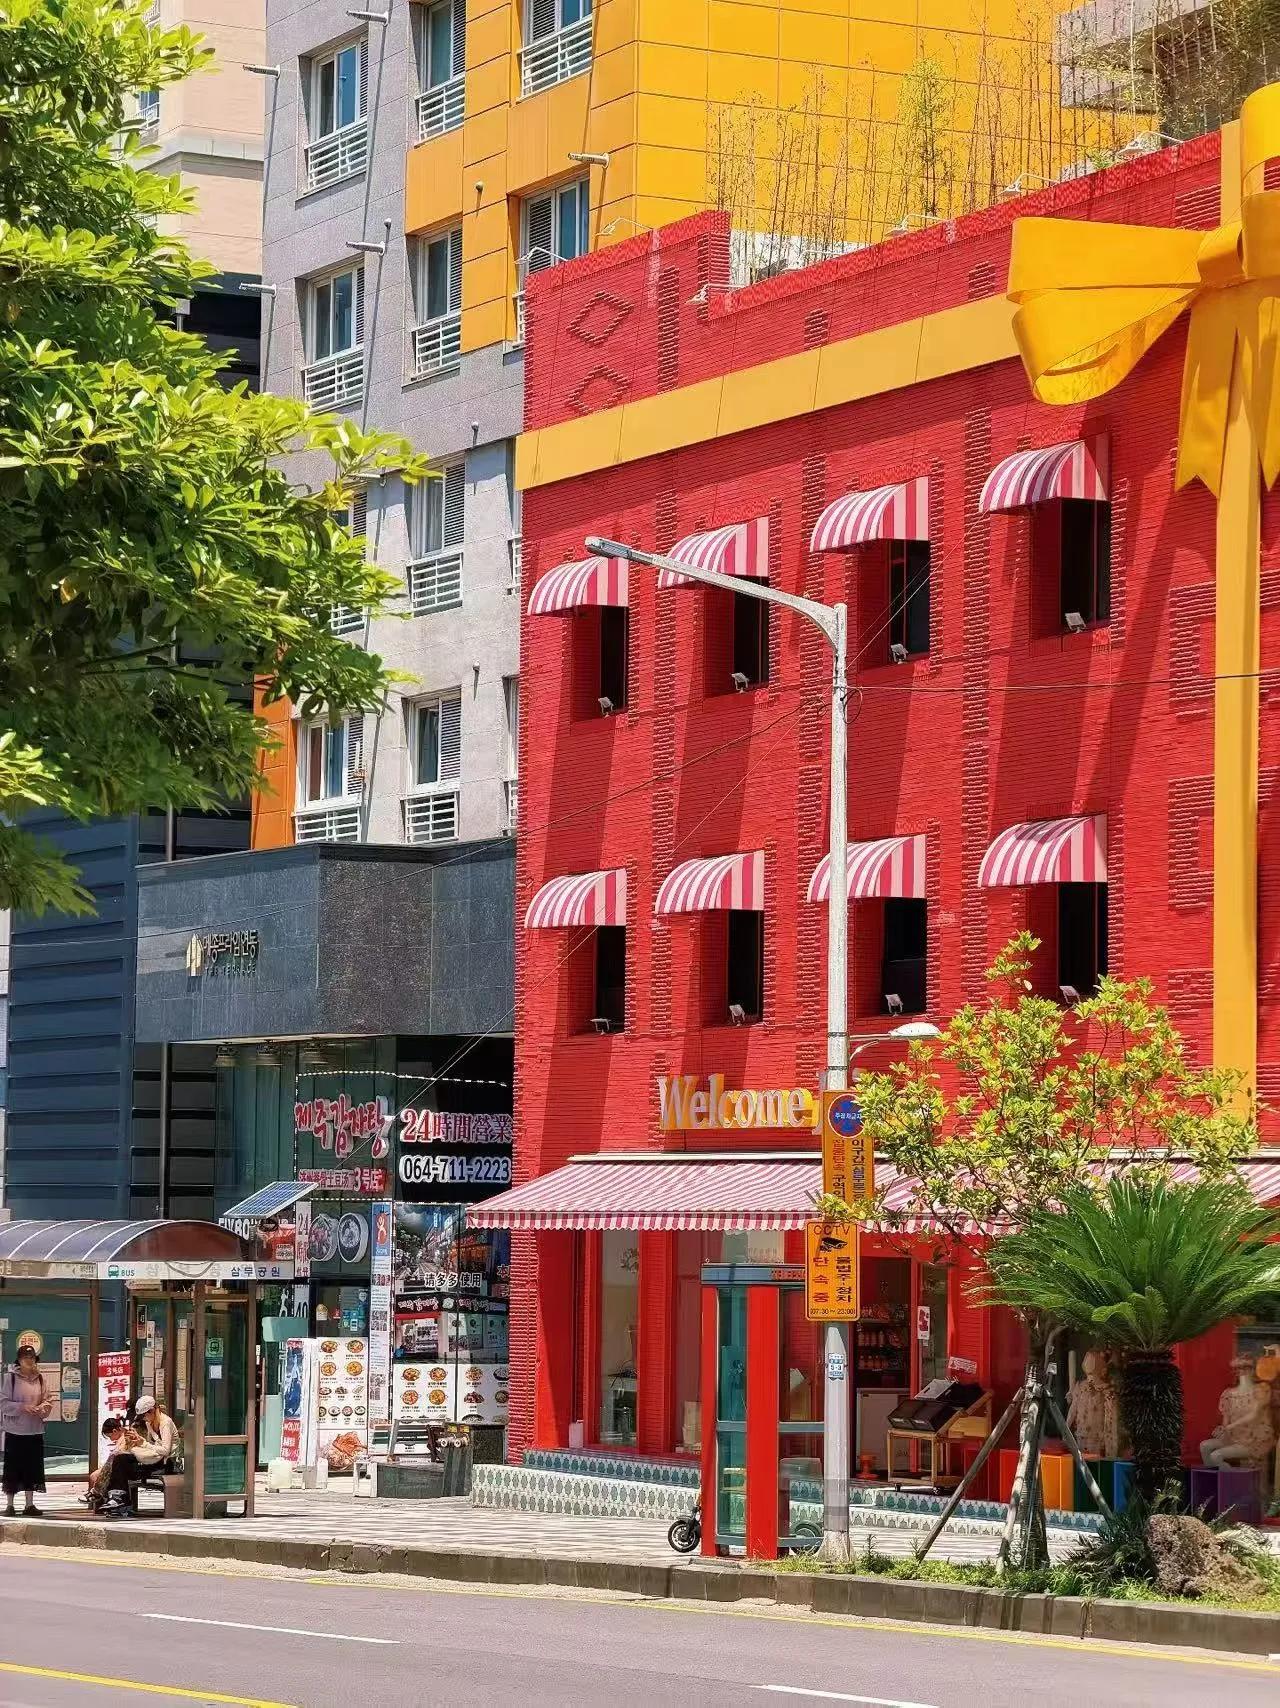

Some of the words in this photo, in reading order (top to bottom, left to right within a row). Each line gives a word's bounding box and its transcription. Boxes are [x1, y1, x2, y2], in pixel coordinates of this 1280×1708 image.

[656, 1073, 815, 1129] Welcome
[294, 1093, 389, 1159] 제주감자탕
[400, 1155, 512, 1183] 064-711-2223
[813, 1224, 851, 1235] CCTV
[121, 1268, 135, 1277] BUS
